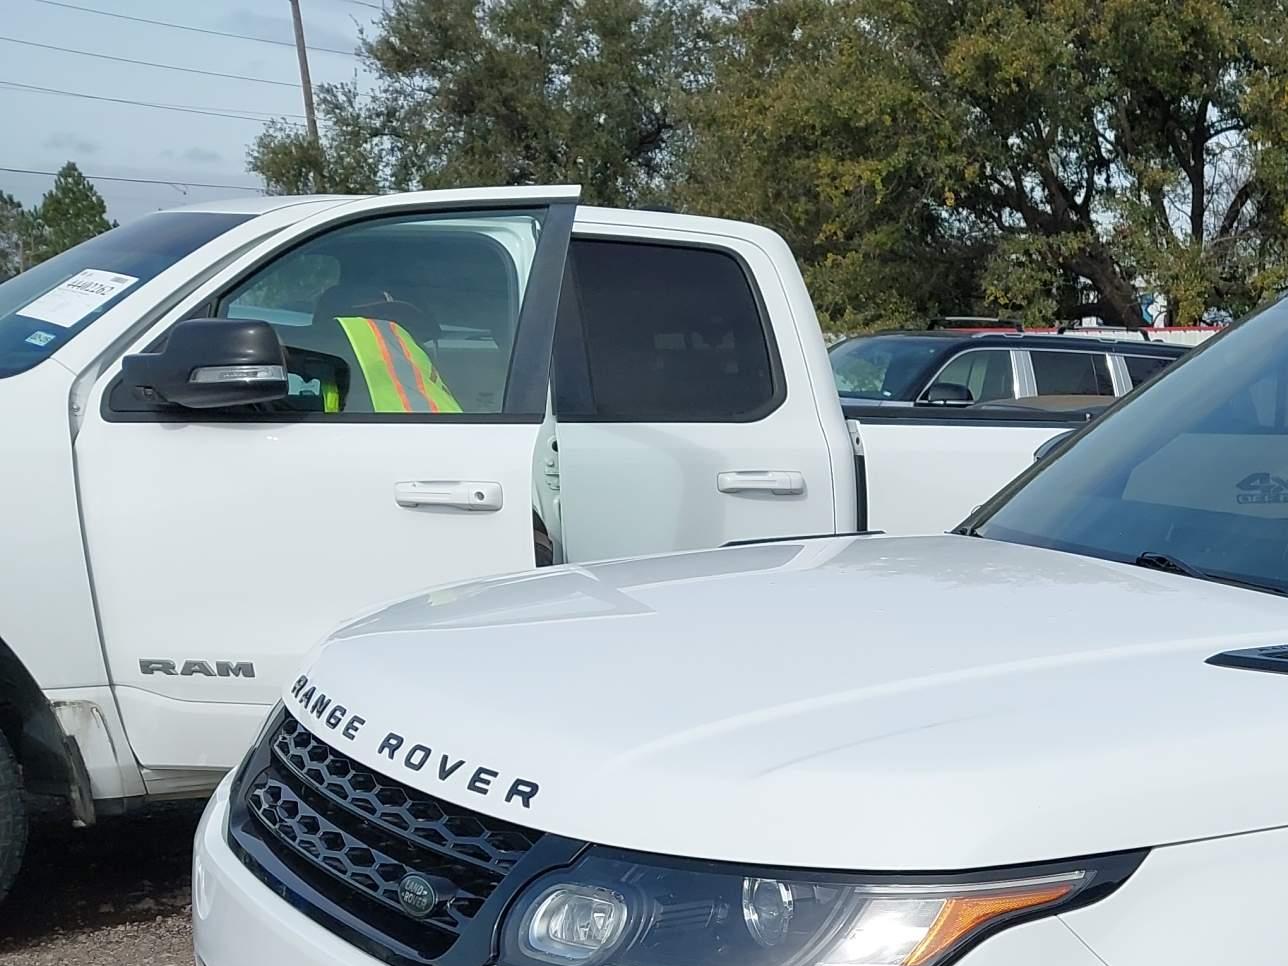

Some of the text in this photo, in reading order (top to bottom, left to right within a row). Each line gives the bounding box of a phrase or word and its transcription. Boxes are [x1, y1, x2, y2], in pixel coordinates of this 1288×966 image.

[138, 658, 256, 678] RAM
[290, 674, 539, 809] RANGE ROVER
[404, 879, 425, 896] LAND
[403, 890, 428, 909] ROVER
